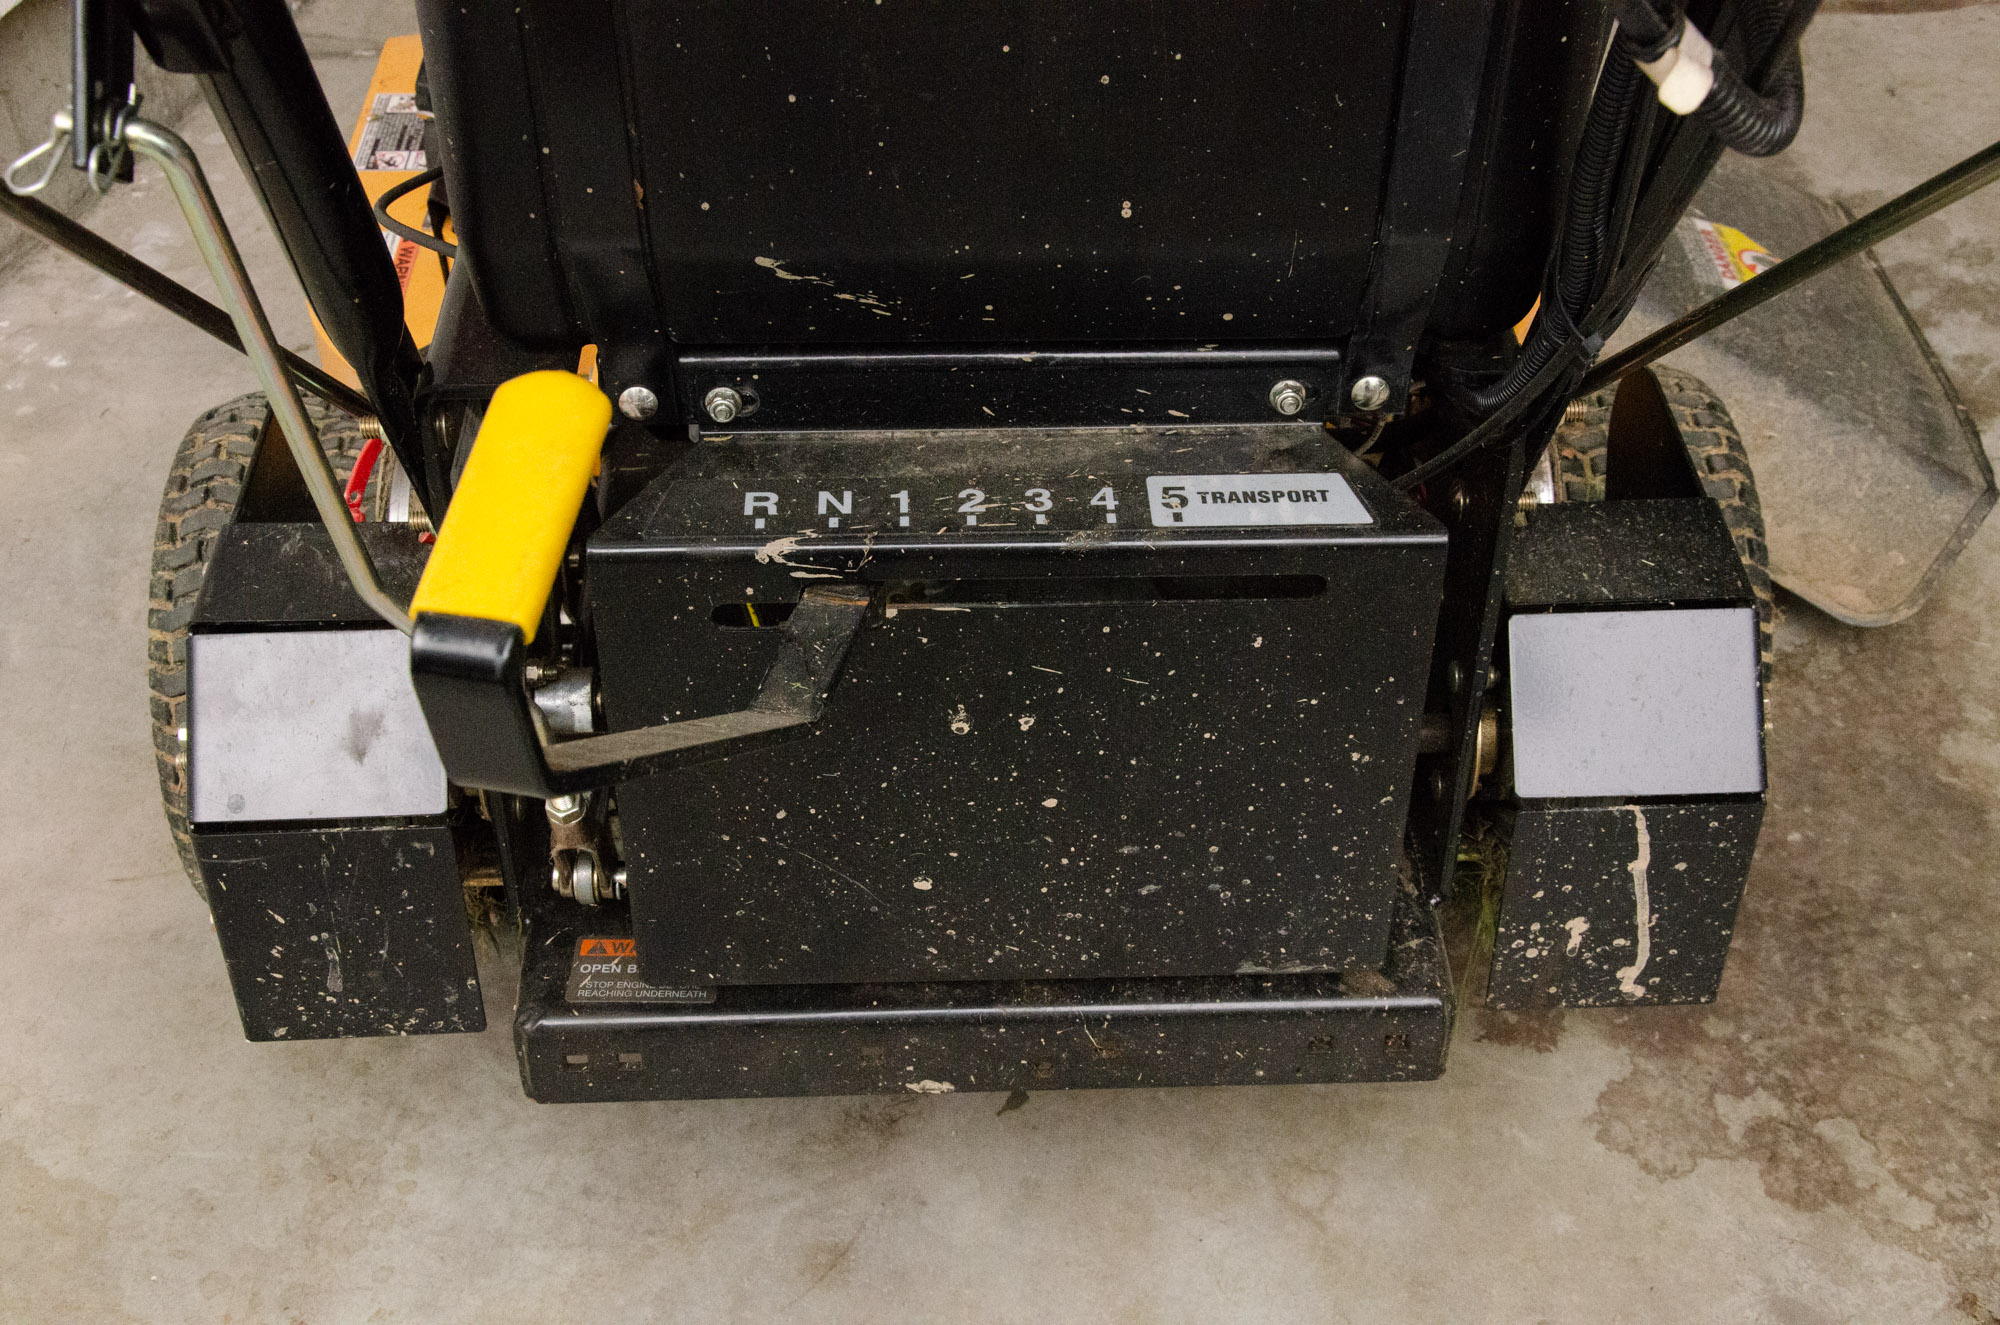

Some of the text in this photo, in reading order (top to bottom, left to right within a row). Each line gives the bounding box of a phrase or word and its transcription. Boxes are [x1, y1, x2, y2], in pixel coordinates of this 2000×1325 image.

[743, 486, 1330, 516] R N 1 2 3 4 5 TRANSPORT
[580, 963, 622, 974] OPEN
[585, 980, 614, 989] STOP
[616, 981, 656, 989] ENGIN
[577, 989, 707, 998] REACHING UNDERNEATH
